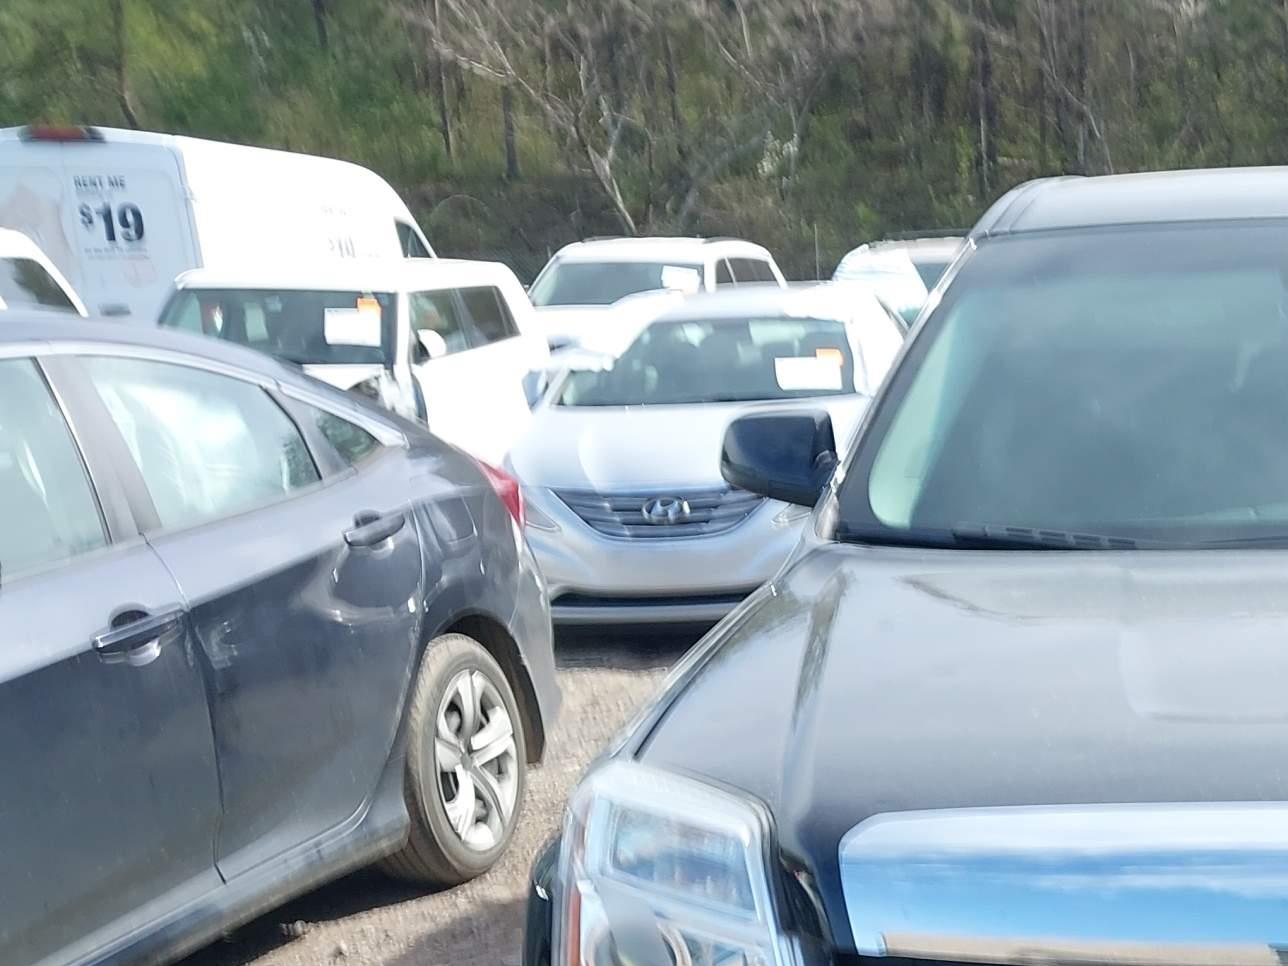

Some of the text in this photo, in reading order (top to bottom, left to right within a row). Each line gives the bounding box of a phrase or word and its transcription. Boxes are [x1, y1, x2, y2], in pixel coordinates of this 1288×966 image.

[74, 176, 126, 189] RENT ME
[79, 201, 145, 242] $19
